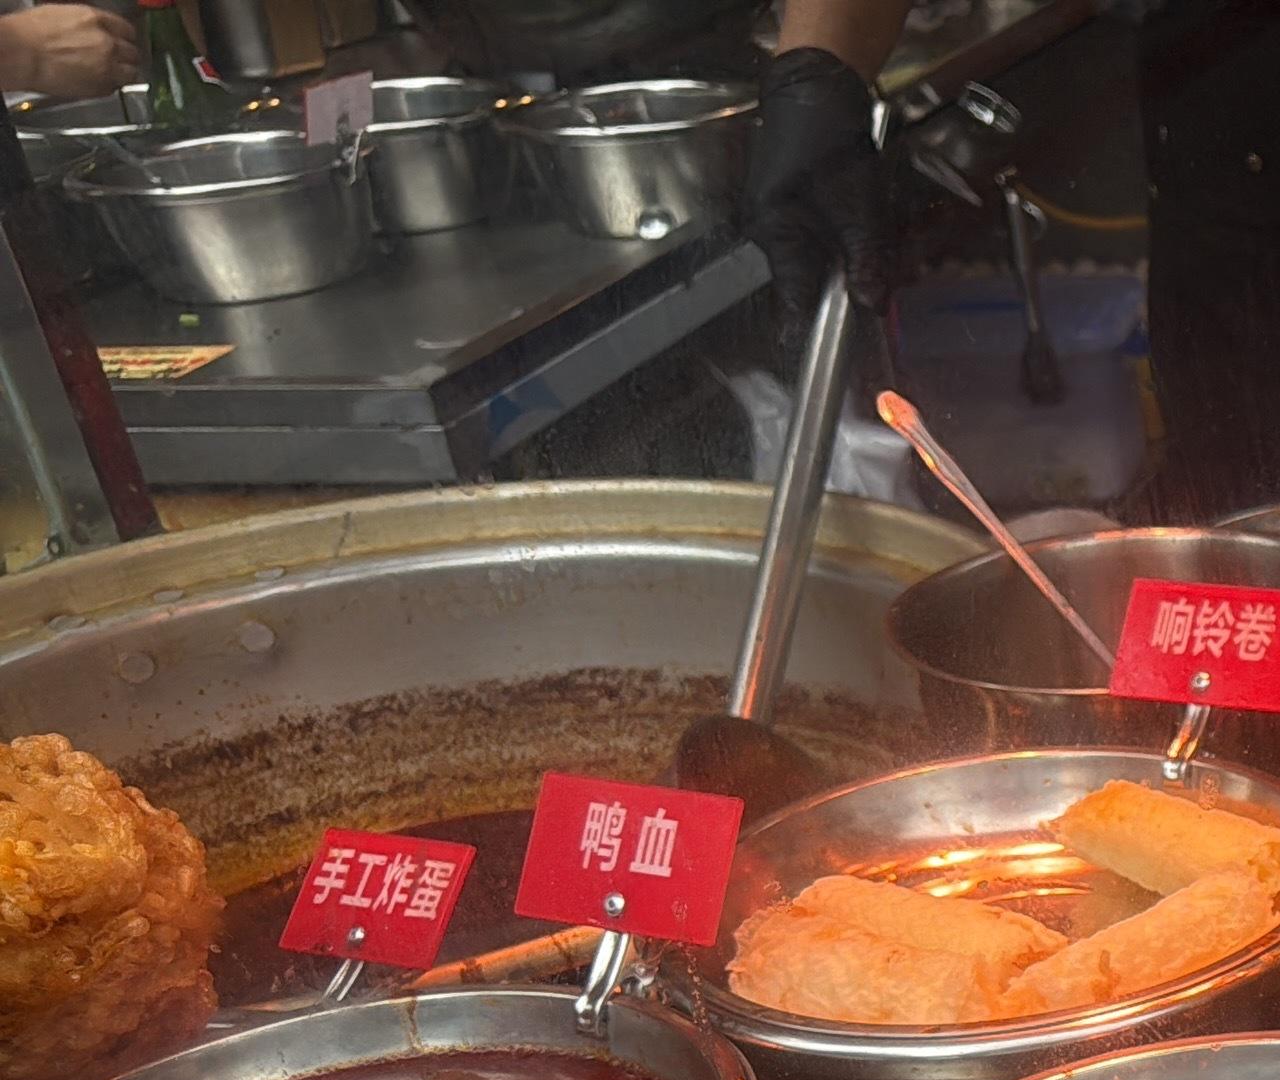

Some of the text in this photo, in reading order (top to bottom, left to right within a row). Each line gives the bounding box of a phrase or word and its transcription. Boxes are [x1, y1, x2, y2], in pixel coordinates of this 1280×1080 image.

[1151, 597, 1277, 662] 响铃卷
[580, 801, 679, 878] 鸭血
[312, 847, 456, 920] 手工炸蛋
